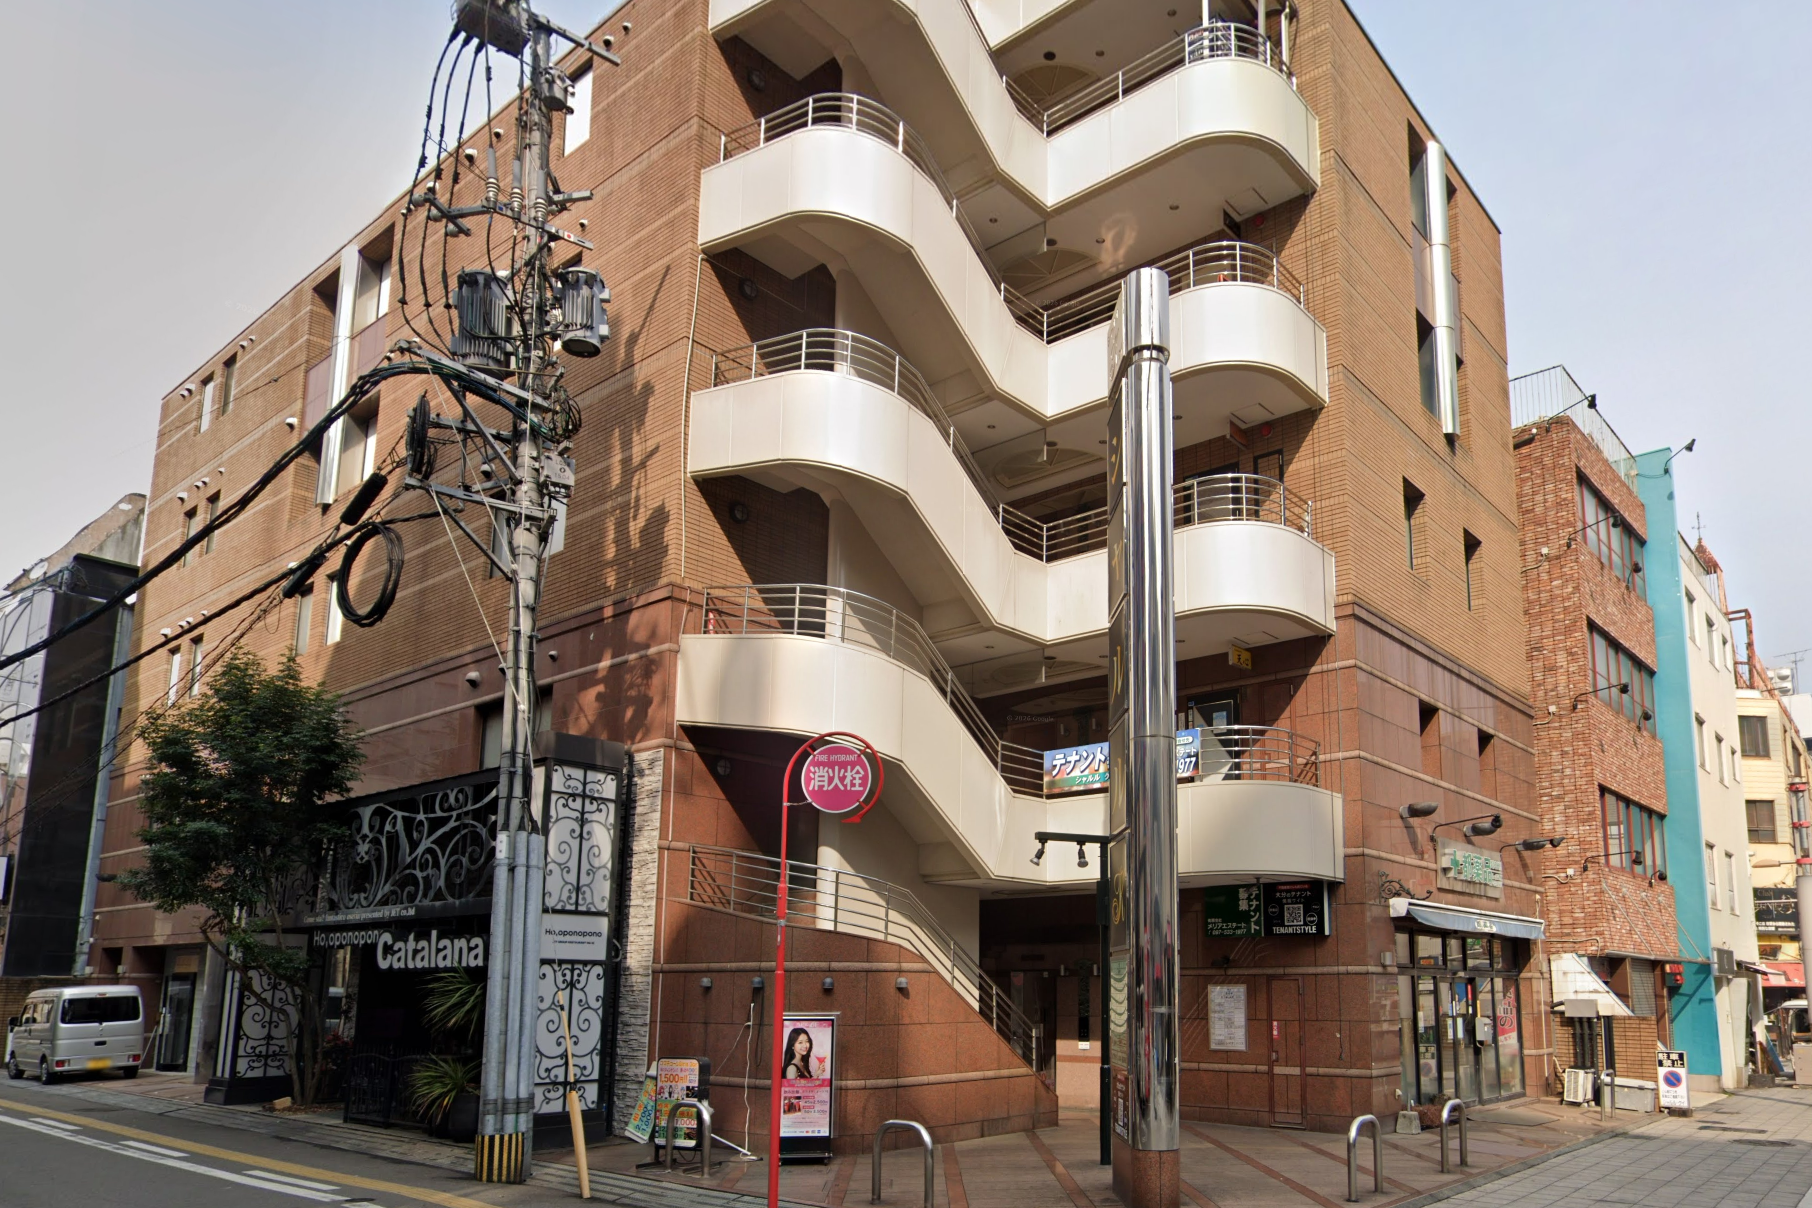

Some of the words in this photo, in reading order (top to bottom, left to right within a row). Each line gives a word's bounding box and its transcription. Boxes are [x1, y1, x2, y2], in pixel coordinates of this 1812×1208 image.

[814, 754, 829, 762] FIRE
[830, 754, 858, 762] HYDRANT
[1051, 746, 1109, 777] テナント
[808, 765, 865, 791] 消火栓
[1249, 885, 1260, 934] テナント
[545, 928, 603, 938] Ho,oponopono
[1207, 922, 1248, 930] メリアエステート
[1273, 925, 1317, 934] TENANTSTYLE
[313, 929, 380, 950] Ho,oponopon
[376, 929, 485, 970] Catalana
